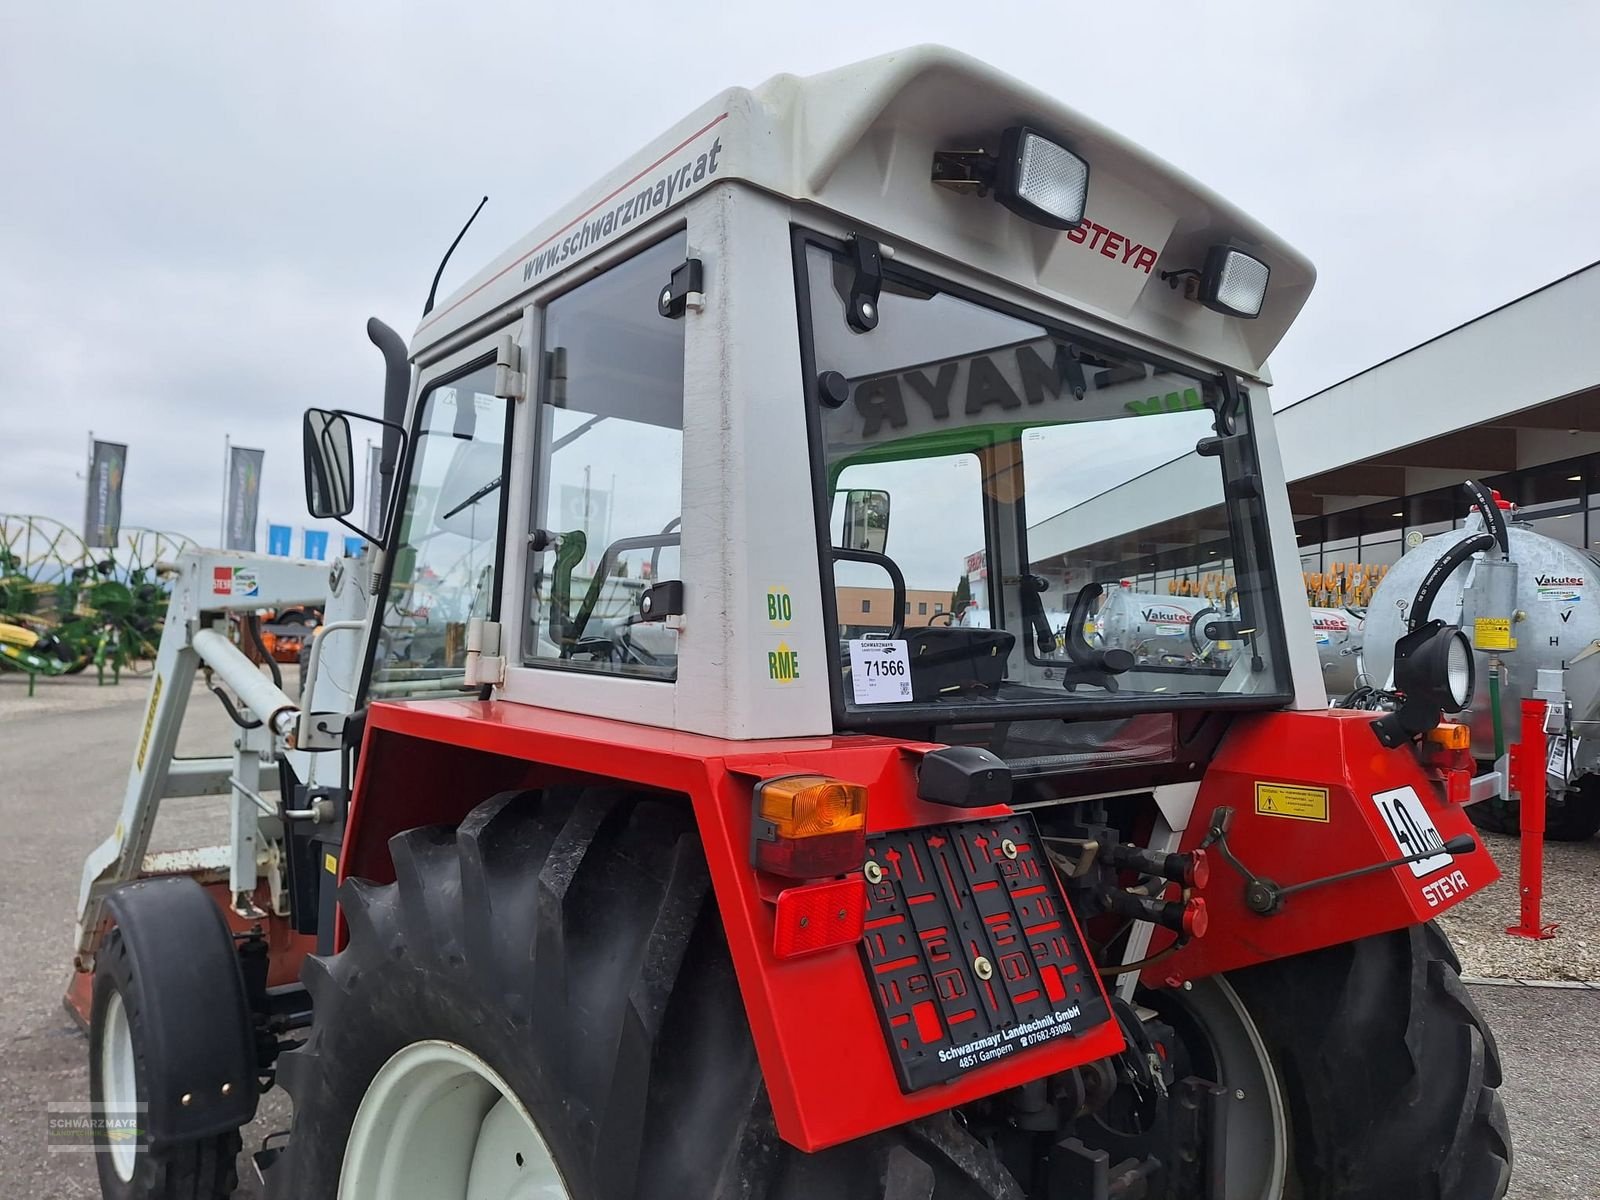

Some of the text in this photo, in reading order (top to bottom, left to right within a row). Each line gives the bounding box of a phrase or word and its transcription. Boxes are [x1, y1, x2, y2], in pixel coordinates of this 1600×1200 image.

[523, 136, 722, 282] www.schwarzmayr.at
[1066, 218, 1158, 274] STEYR
[1535, 574, 1583, 586] Vakutec
[767, 593, 792, 621] BIO
[1141, 608, 1193, 622] Vakutec
[1560, 610, 1572, 623] V
[1312, 618, 1347, 627] utec
[1549, 636, 1559, 647] H
[768, 651, 800, 679] RME
[864, 660, 905, 677] 71566
[1562, 660, 1570, 670] L
[1421, 869, 1469, 907] STEYR
[938, 1005, 1081, 1063] Schwarzmayr Landtechnik GmbH
[959, 1021, 1072, 1069] 4851 Gampern 07682-93080
